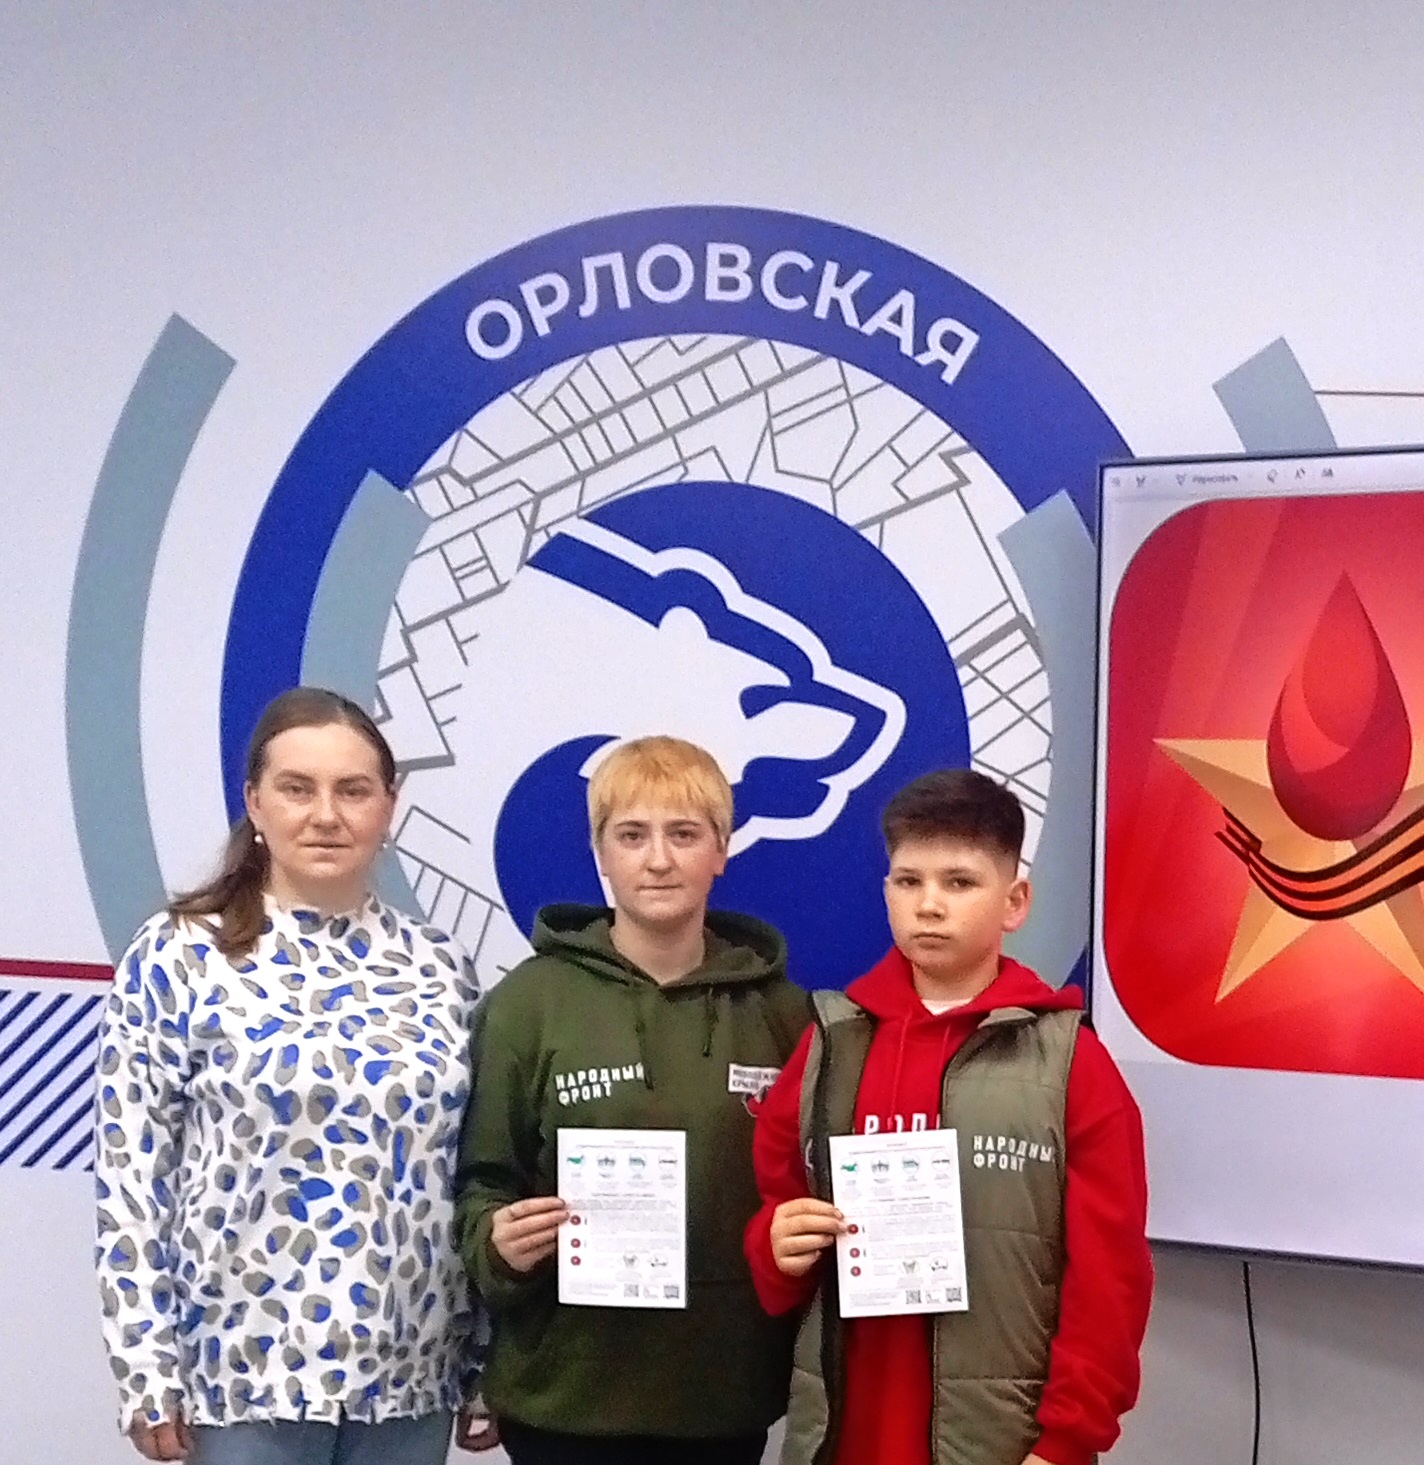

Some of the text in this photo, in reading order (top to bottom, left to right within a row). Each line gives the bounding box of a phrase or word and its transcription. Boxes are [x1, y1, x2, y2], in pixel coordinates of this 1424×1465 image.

[465, 242, 980, 385] ОРЛОВСКАЯ
[973, 1135, 1054, 1163] НАРОДНЫ
[973, 1152, 1026, 1173] ФРОНТ
